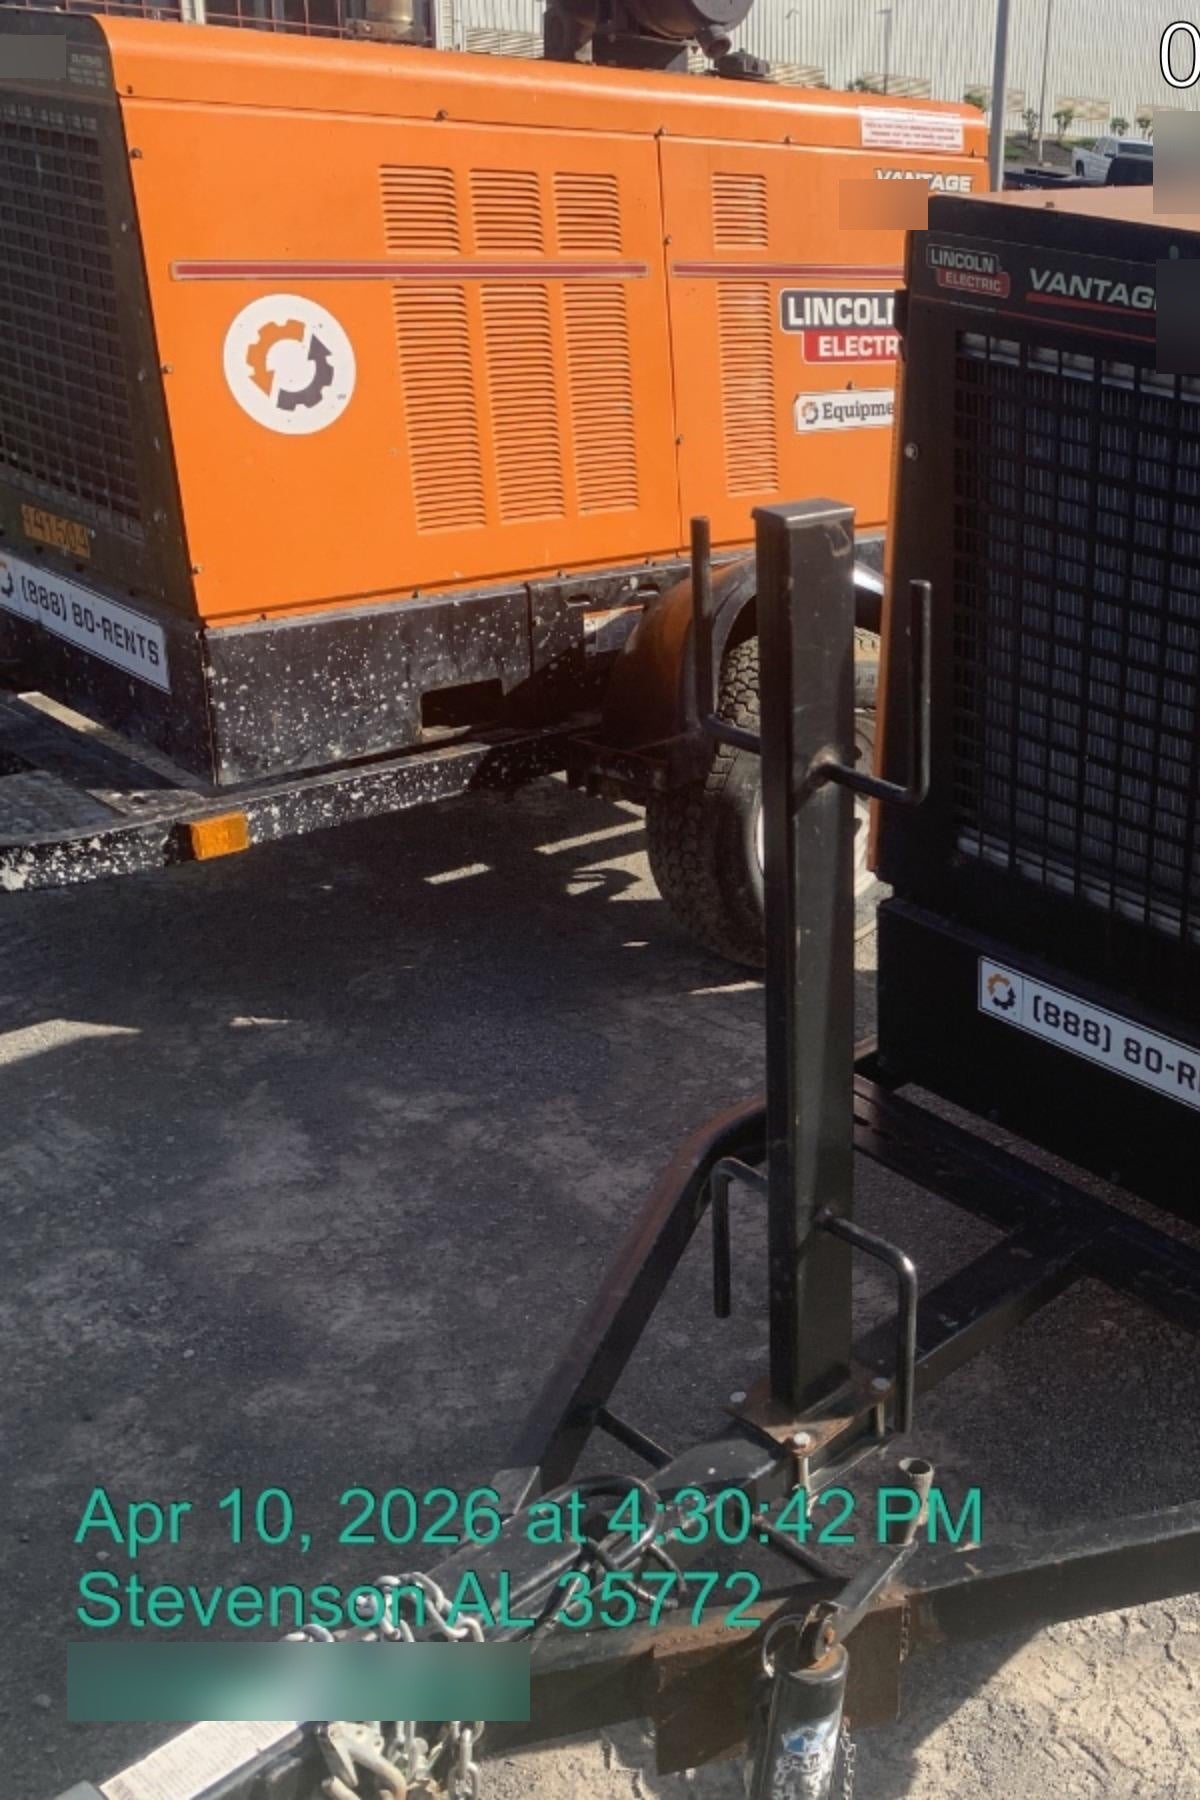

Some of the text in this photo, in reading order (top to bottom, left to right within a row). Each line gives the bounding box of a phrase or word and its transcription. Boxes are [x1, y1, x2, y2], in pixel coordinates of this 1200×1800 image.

[930, 248, 995, 273] LINCOLN
[945, 271, 1001, 293] ELECTRIC
[1029, 267, 1157, 311] VANTAG
[21, 575, 160, 666] (888) 80-RENTS
[1032, 994, 1112, 1053] (888)
